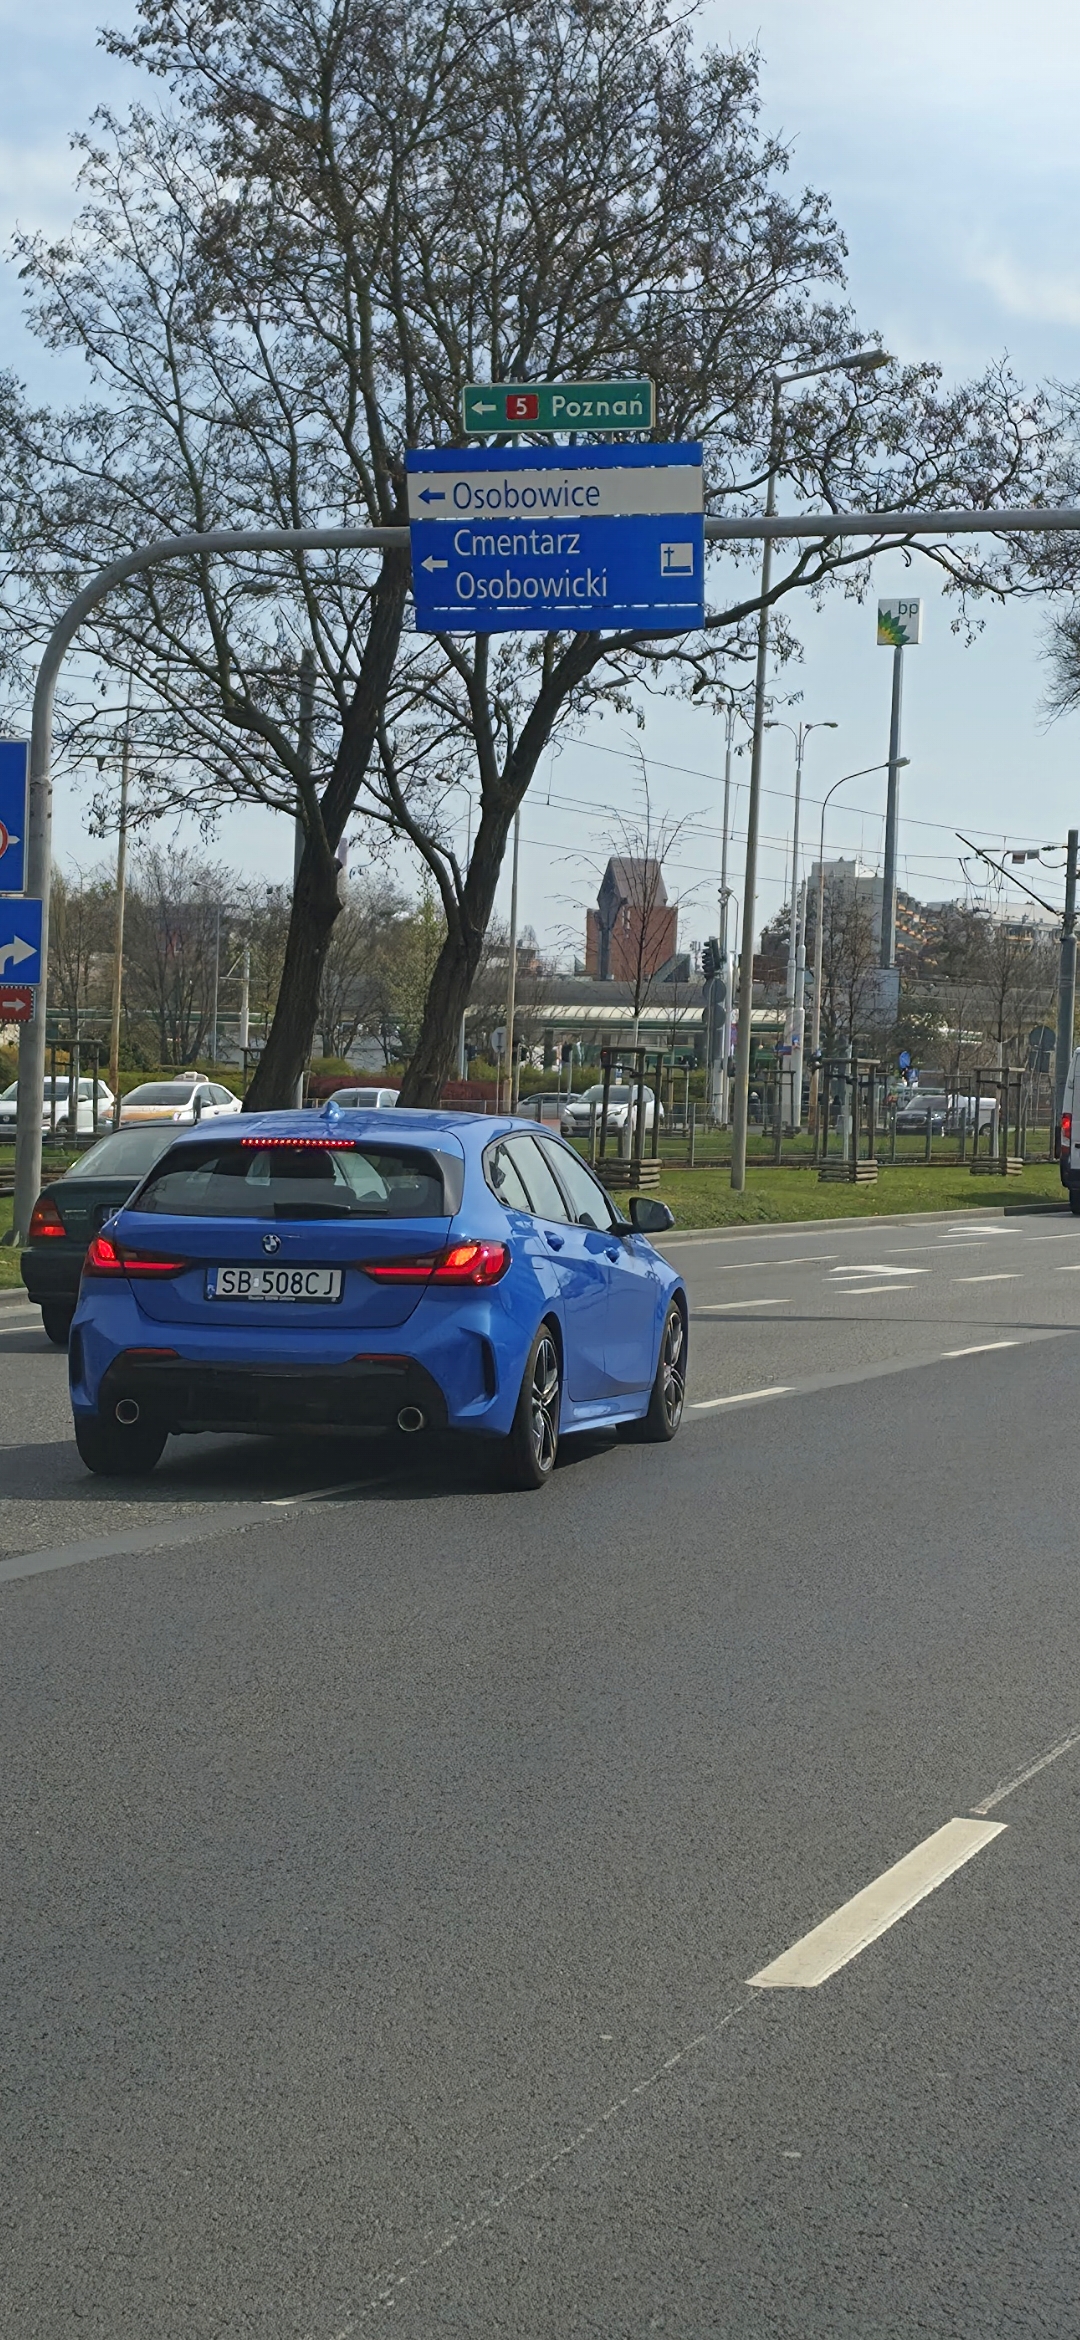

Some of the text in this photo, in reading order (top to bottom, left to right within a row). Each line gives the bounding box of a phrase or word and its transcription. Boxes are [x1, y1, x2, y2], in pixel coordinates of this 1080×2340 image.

[516, 393, 643, 417] 5 Poznań
[453, 479, 600, 509] Osobowice
[454, 528, 581, 556] Cmentarz
[456, 568, 607, 599] Osobowicki
[898, 600, 919, 619] bp
[222, 1270, 252, 1294] SB
[261, 1270, 334, 1295] 508CJ
